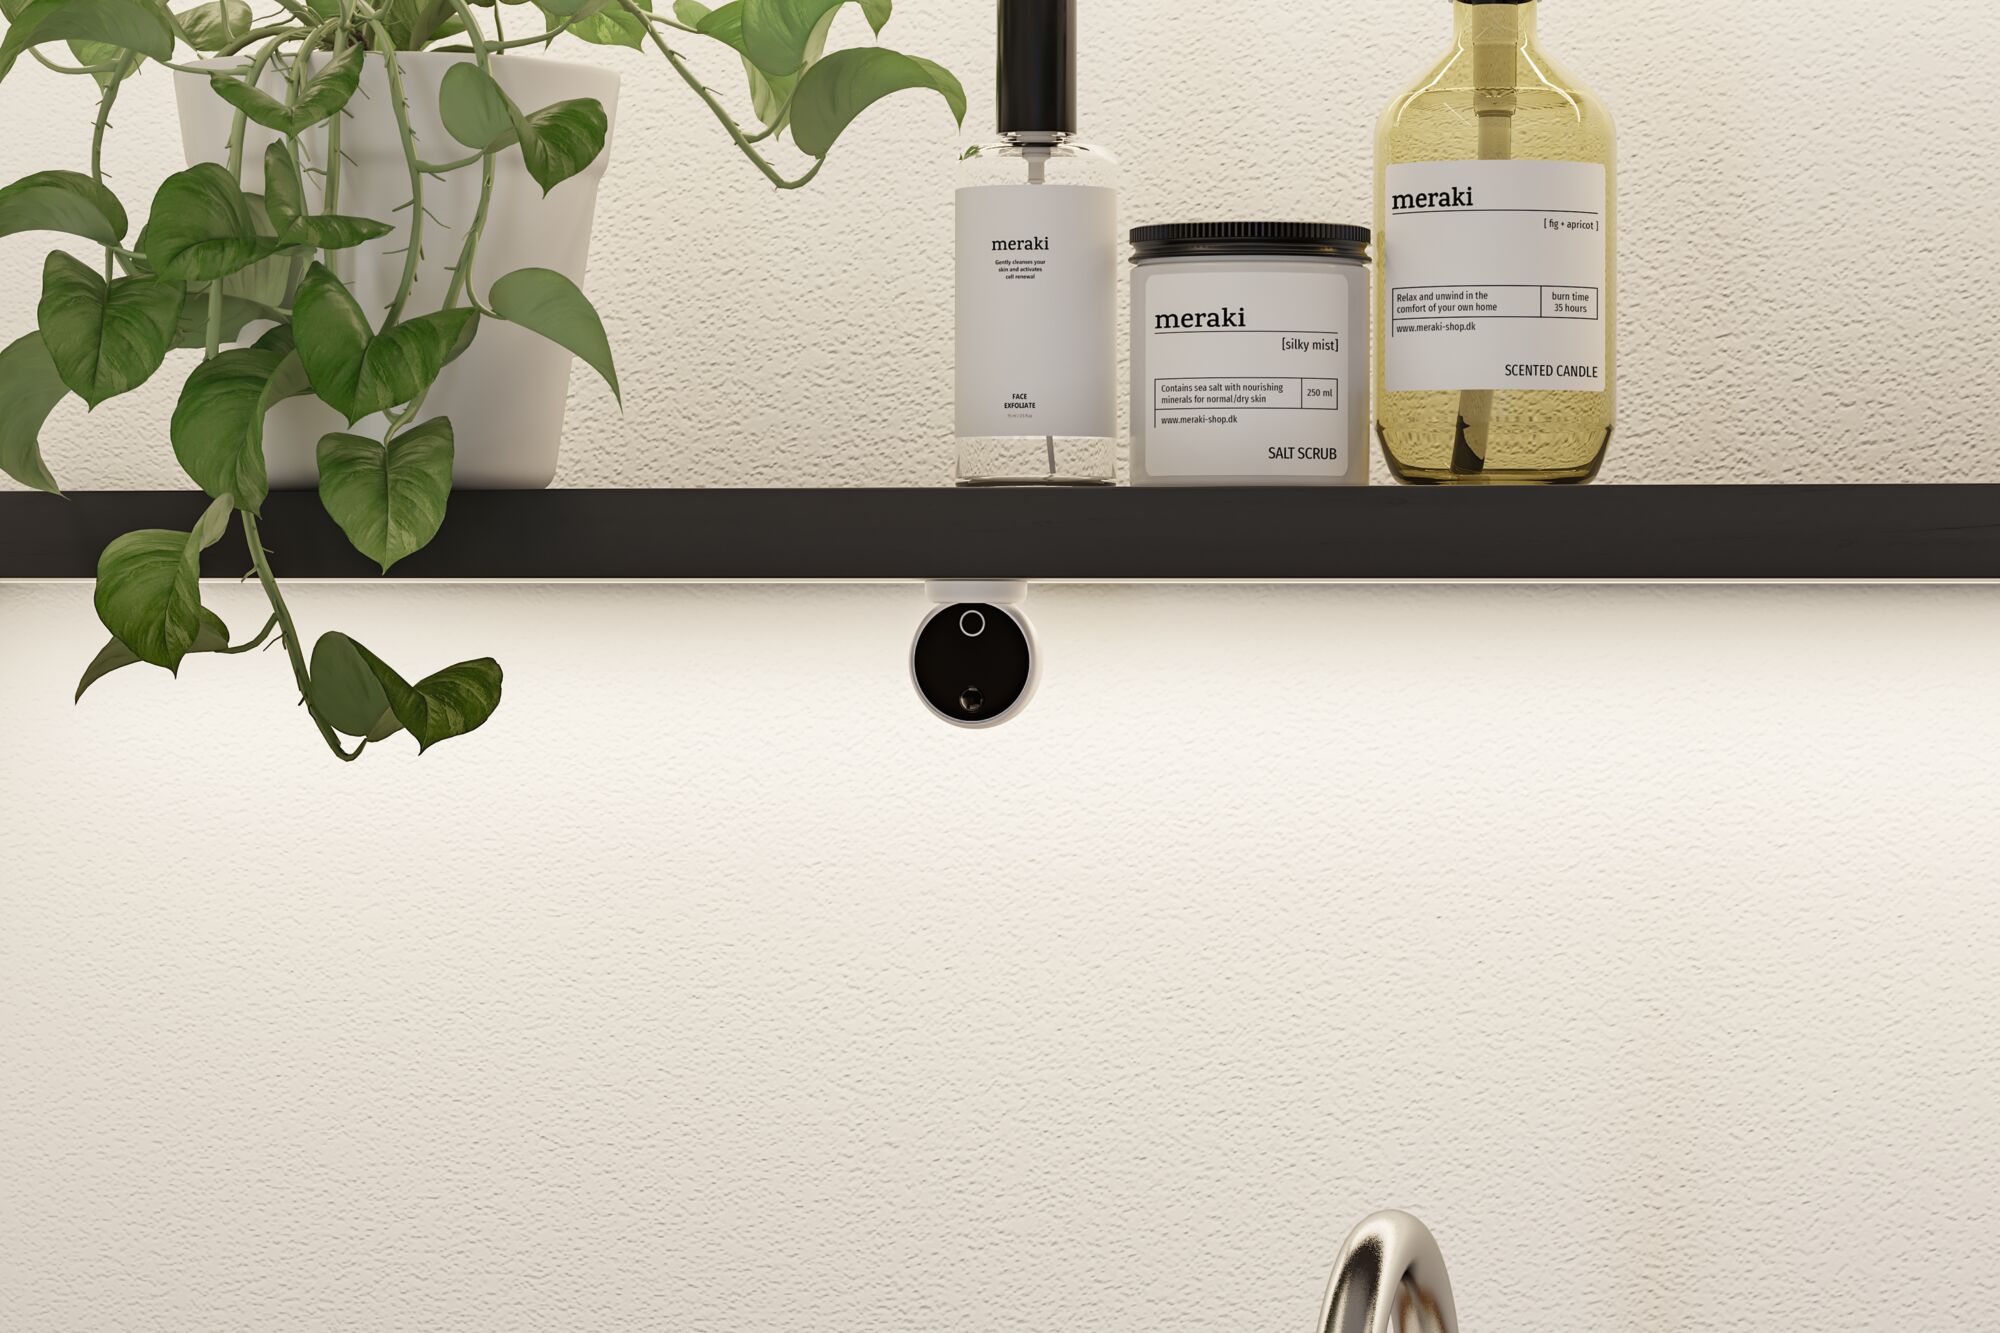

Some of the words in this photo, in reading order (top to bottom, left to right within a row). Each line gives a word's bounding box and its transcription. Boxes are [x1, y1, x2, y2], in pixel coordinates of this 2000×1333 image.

[1392, 187, 1473, 209] meraki
[1549, 219, 1559, 230] fig
[1567, 220, 1594, 230] apricot
[992, 237, 1049, 250] meraki
[1397, 292, 1417, 302] Relax
[1419, 292, 1434, 301] and
[1436, 292, 1464, 301] unwind
[1466, 292, 1473, 300] in
[1475, 291, 1488, 300] the
[1552, 292, 1570, 301] burn
[1572, 292, 1589, 301] time
[1397, 304, 1426, 313] comfort
[1428, 304, 1436, 312] of
[1438, 305, 1455, 313] your
[1476, 303, 1497, 311] home
[1554, 304, 1563, 312] 35
[1565, 304, 1587, 313] hours
[1154, 307, 1246, 329] meraki
[1396, 322, 1476, 333] www.meraki-shop.dk
[1282, 337, 1309, 352] [silky
[1312, 339, 1339, 352] mist]
[1505, 364, 1553, 377] SCENTED
[1556, 365, 1598, 378] CANDLE
[1161, 384, 1192, 392] Contains
[1194, 384, 1207, 392] sea
[1209, 383, 1222, 391] salt
[1224, 383, 1241, 391] with
[1243, 383, 1283, 393] nourishing
[1307, 389, 1320, 397] 250
[1323, 389, 1332, 397] ml
[1161, 396, 1192, 404] minerals
[1194, 395, 1205, 403] for
[1206, 395, 1249, 403] normal/dry
[1250, 395, 1266, 403] skin
[1161, 415, 1238, 424] www.meraki-shop.dk
[1268, 446, 1295, 460] SALT
[1297, 447, 1337, 460] SCRUB
